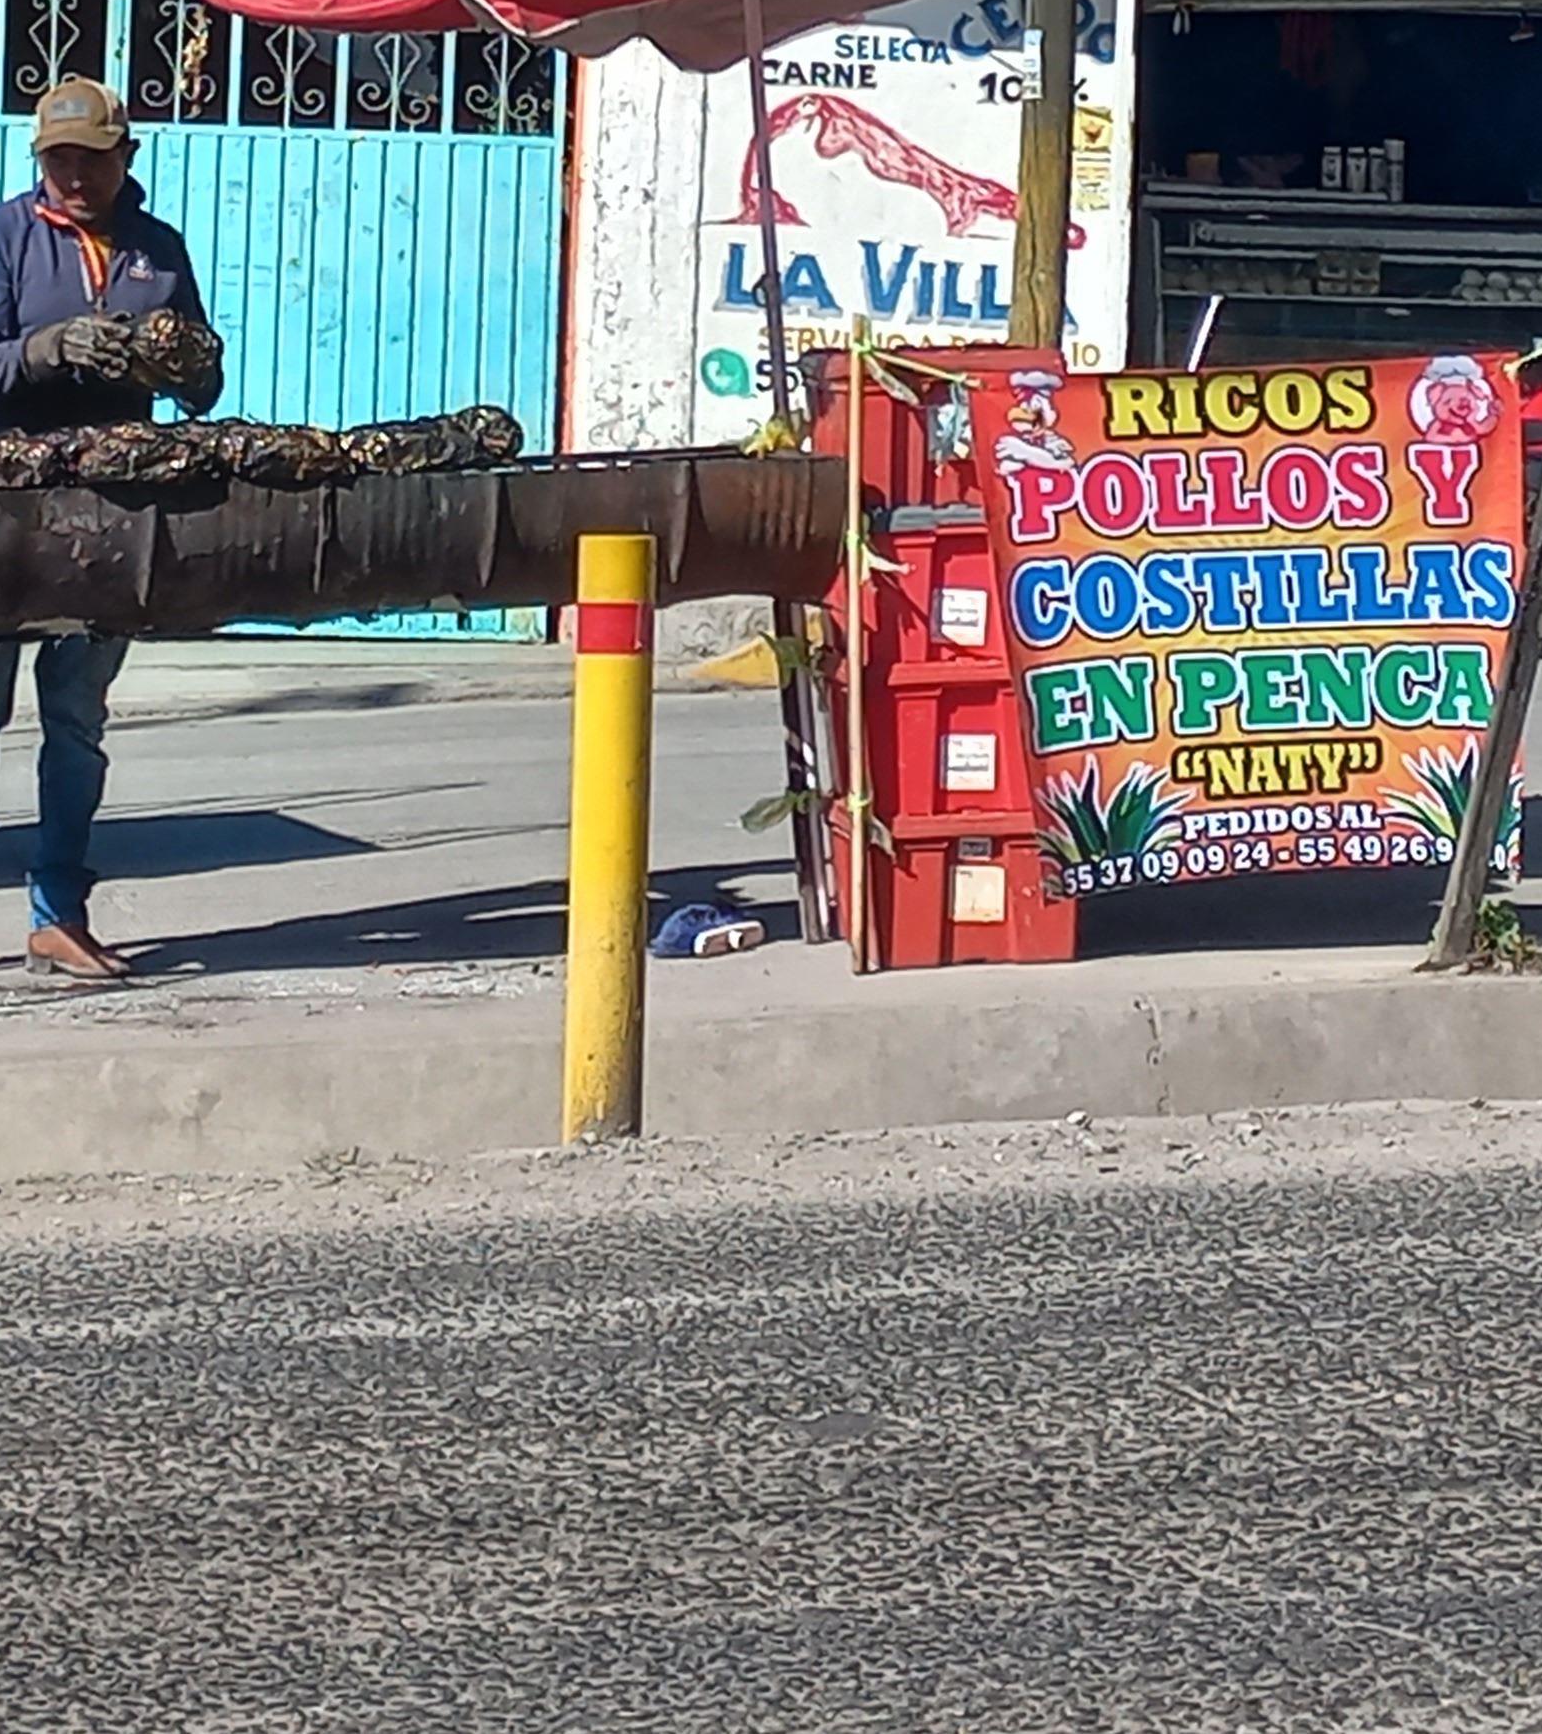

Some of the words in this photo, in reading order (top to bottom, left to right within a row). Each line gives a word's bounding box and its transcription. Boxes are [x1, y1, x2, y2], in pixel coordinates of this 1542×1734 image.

[760, 59, 877, 89] CARNE
[834, 34, 953, 65] SELECTA
[1107, 368, 1373, 438] RICOS
[1009, 444, 1388, 543] POLLOS
[1408, 442, 1481, 526] Y
[1012, 540, 1517, 647] COSTILLAS
[1029, 650, 1156, 754] EN
[1170, 644, 1492, 735] PENCA
[1182, 807, 1332, 841] PEDIDOS
[1332, 804, 1383, 831] AL
[1063, 862, 1094, 894] 55
[1100, 856, 1133, 890] 37
[1142, 851, 1179, 880] 09
[1192, 847, 1223, 874] 09
[1230, 843, 1269, 870] 24
[1299, 840, 1335, 866] 55
[1346, 840, 1382, 864] 49
[1390, 839, 1426, 863] 26
